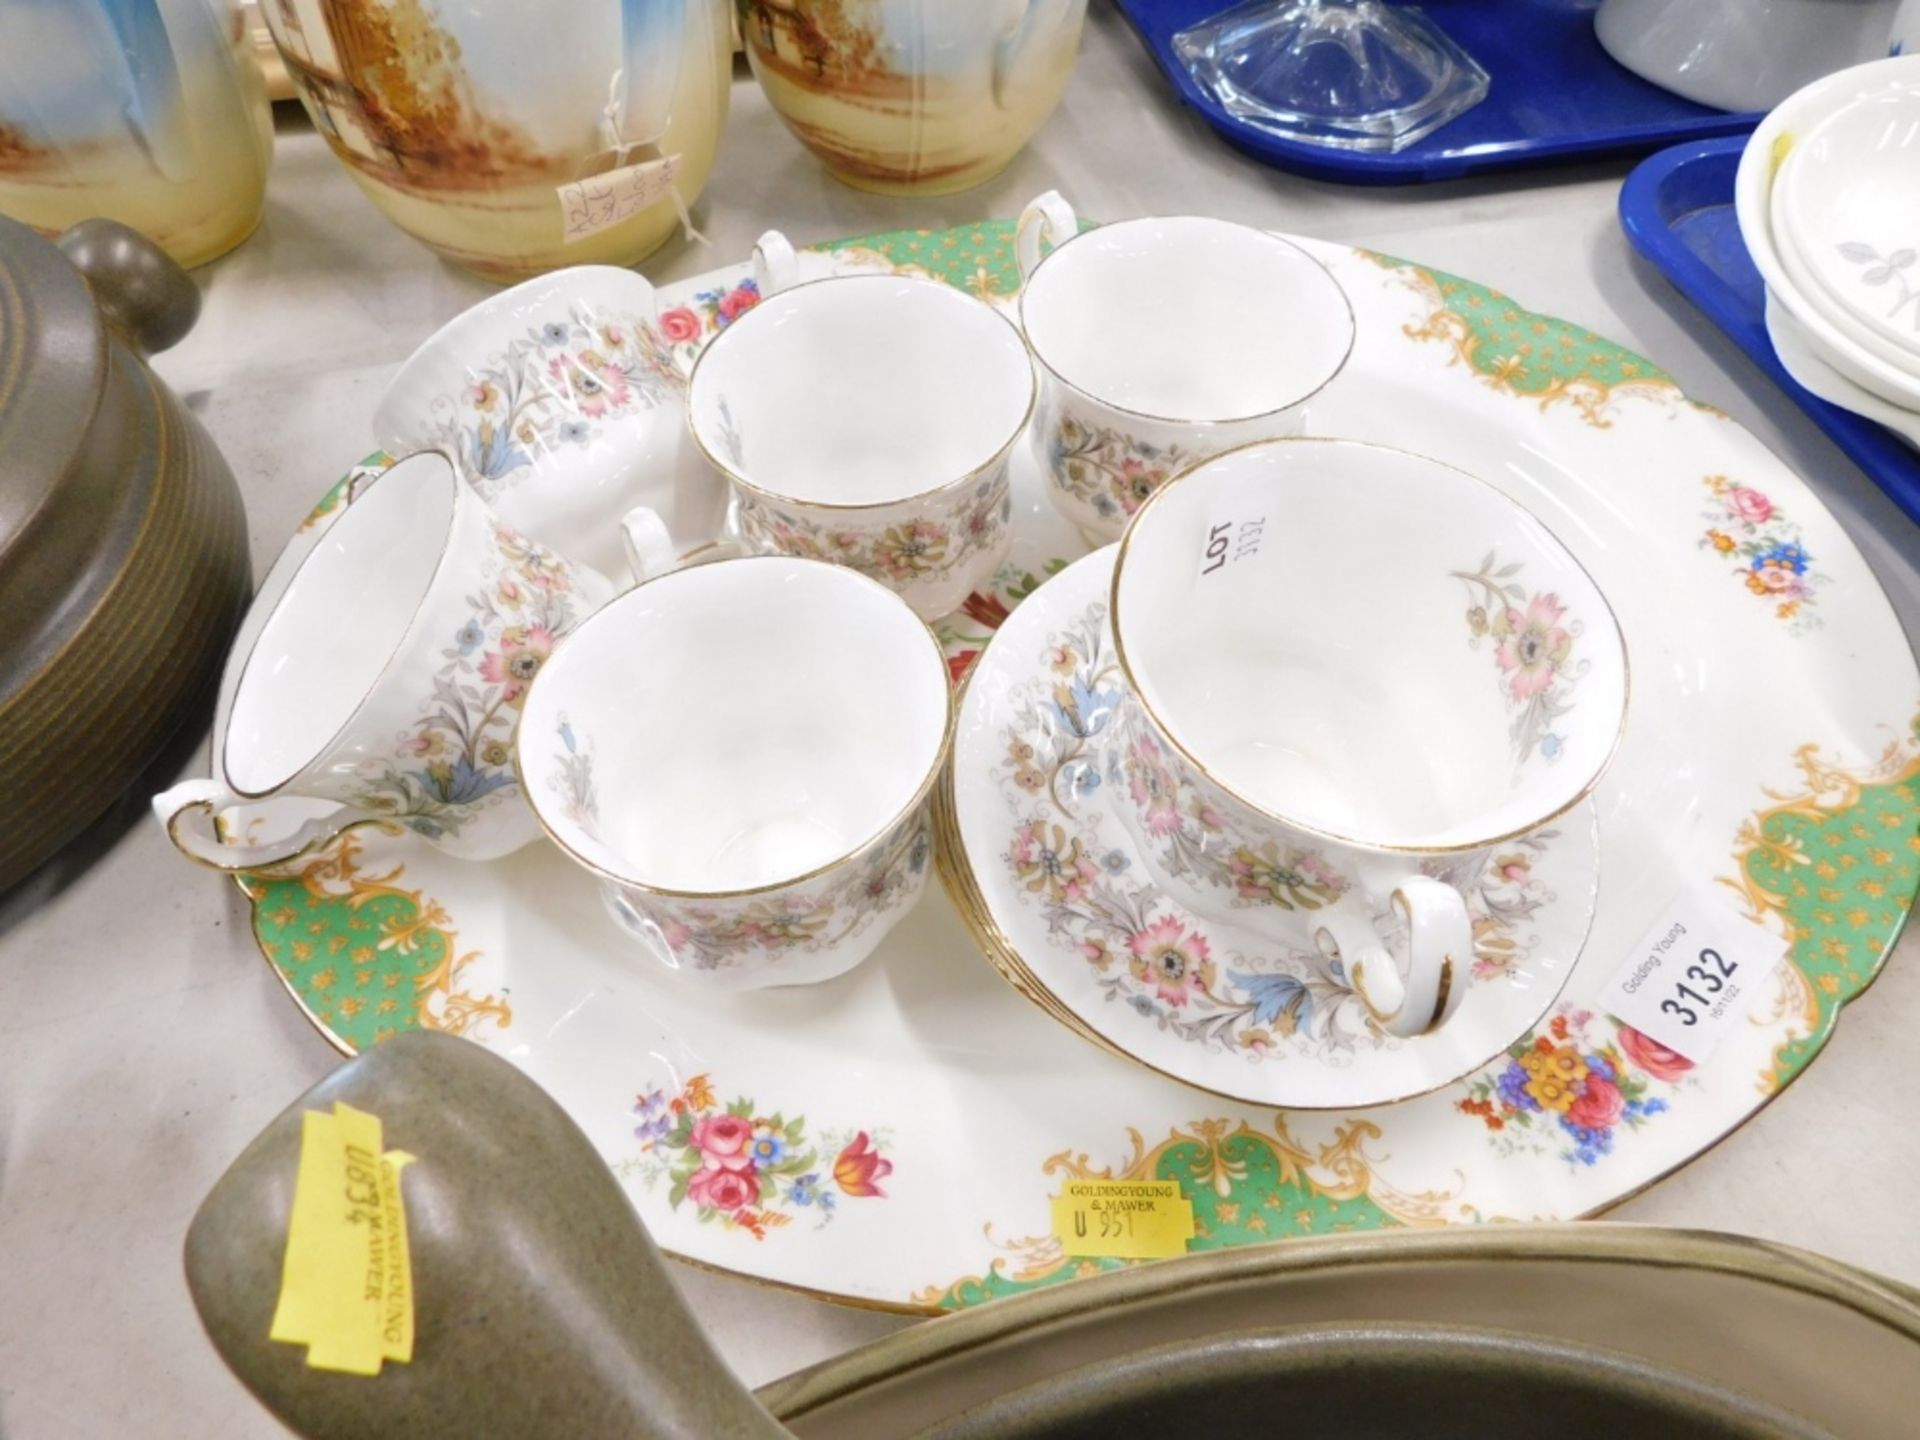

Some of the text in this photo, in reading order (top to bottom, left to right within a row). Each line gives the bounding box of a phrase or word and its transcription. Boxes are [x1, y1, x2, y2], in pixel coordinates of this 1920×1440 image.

[1202, 521, 1232, 575] LOT
[1234, 516, 1266, 562] 3132
[1622, 922, 1687, 994] Golding Young
[1660, 948, 1738, 1026] 3132
[1070, 1184, 1174, 1198] GOLDINGYOUNG
[1091, 1199, 1156, 1212] & MAWER
[1074, 1210, 1087, 1238] U
